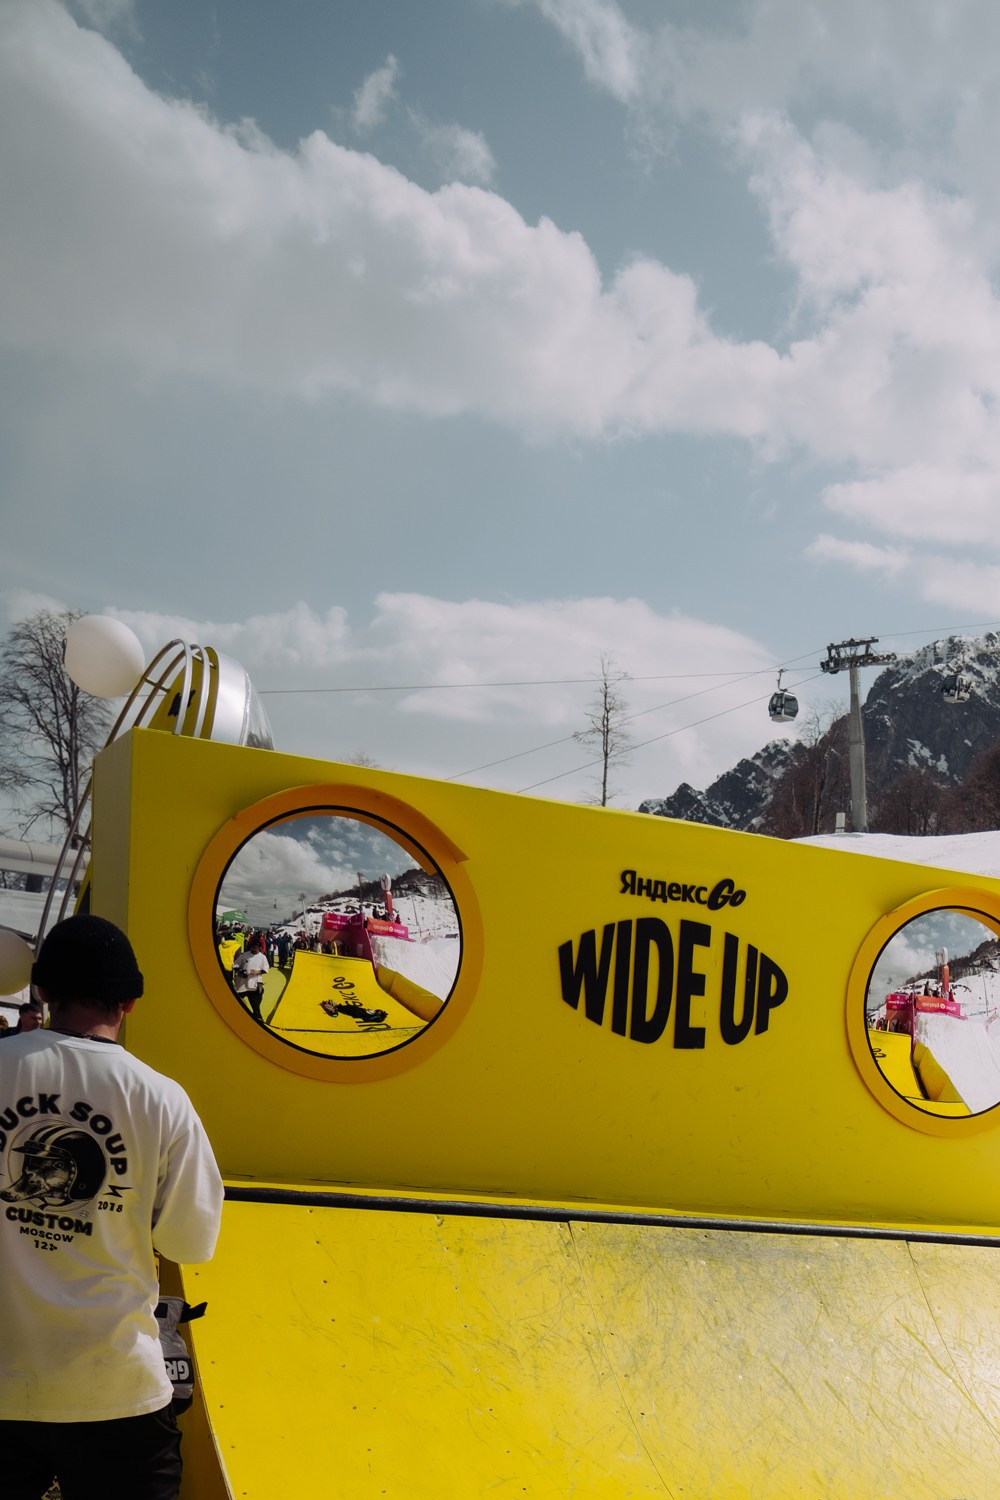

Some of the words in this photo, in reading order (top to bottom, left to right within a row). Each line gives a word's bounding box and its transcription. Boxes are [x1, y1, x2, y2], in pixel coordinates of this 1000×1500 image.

[620, 869, 709, 905] Яндекс
[708, 878, 747, 911] Go
[558, 916, 711, 1050] WIDE
[719, 932, 788, 1046] UP
[69, 1101, 128, 1175] SOUP
[6, 1206, 93, 1237] CUSTOM
[19, 1226, 74, 1243] MOSCOW
